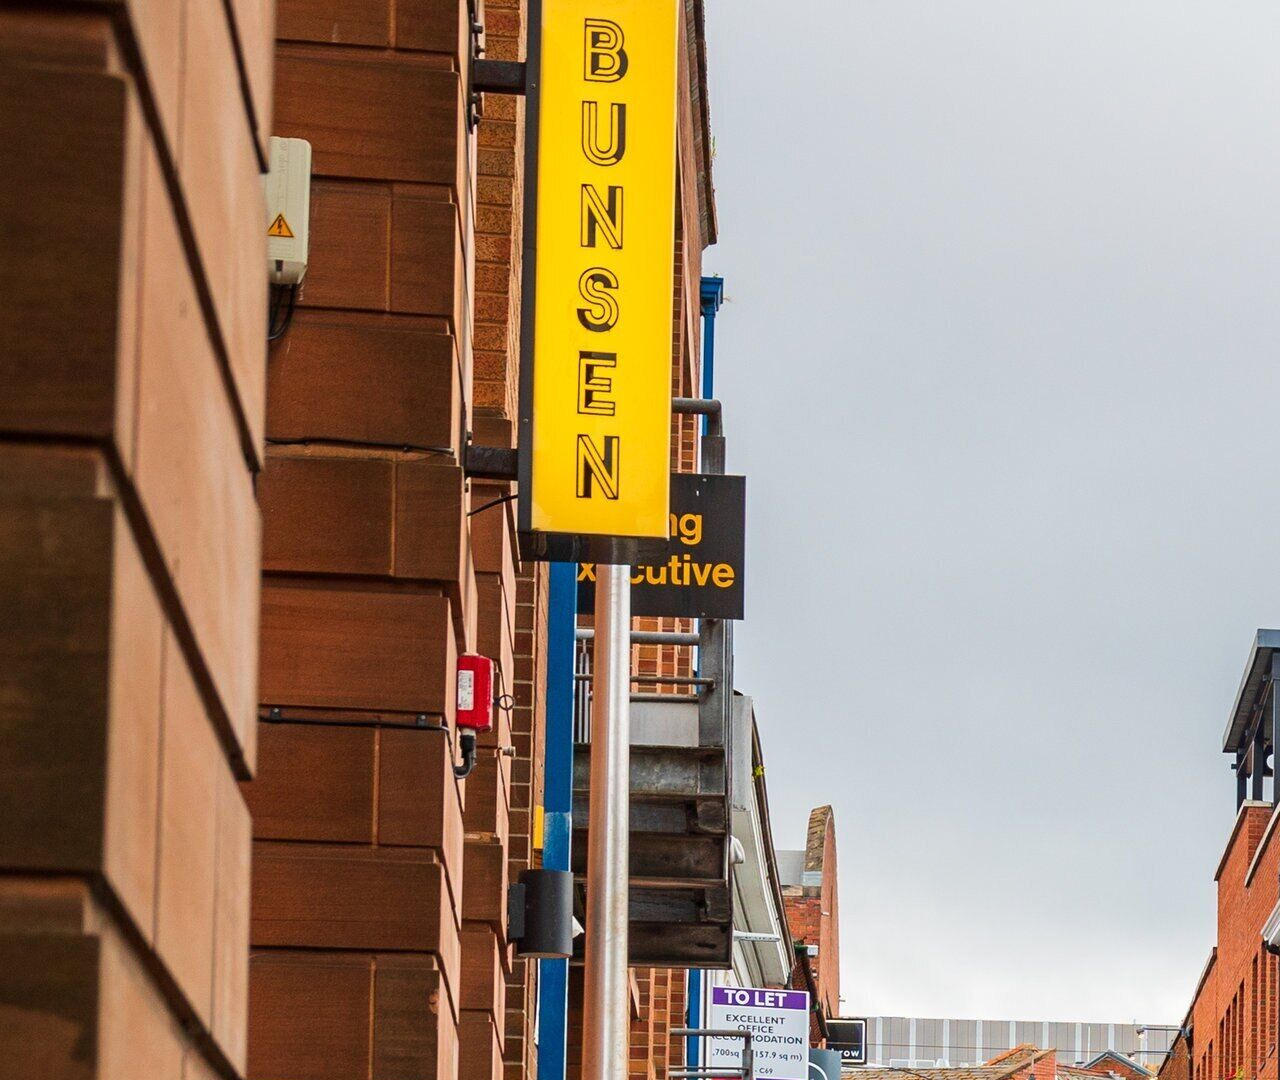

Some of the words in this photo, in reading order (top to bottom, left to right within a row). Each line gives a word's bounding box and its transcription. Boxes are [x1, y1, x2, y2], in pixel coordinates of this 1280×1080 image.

[576, 18, 629, 500] BUNSEN
[724, 989, 750, 1005] TO
[755, 991, 787, 1007] LET
[726, 1014, 786, 1025] EXCELLENT
[738, 1024, 774, 1033] OFFICE
